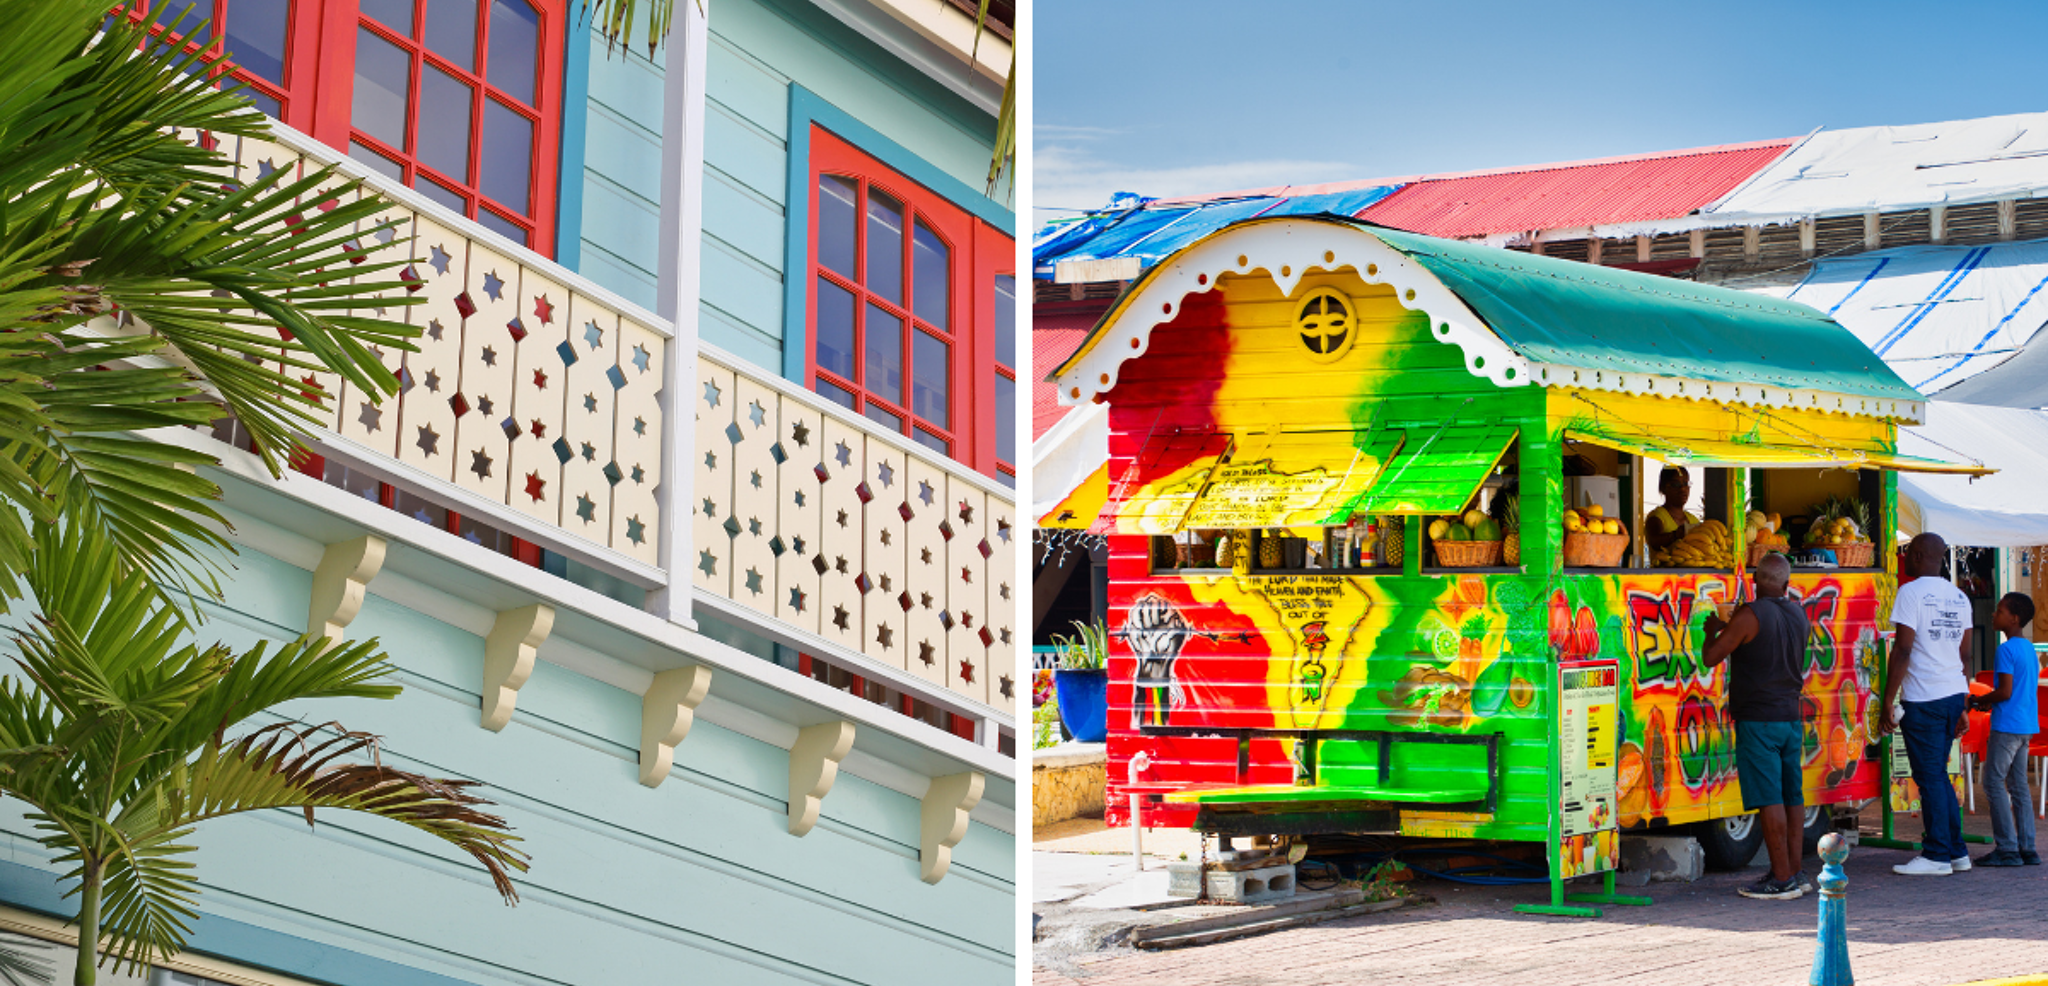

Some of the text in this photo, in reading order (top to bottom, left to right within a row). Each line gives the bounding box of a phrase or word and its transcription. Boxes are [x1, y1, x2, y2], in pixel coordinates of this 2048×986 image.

[1269, 576, 1298, 585] LORD
[1296, 586, 1315, 596] AND
[1288, 611, 1330, 619] OUT OF
